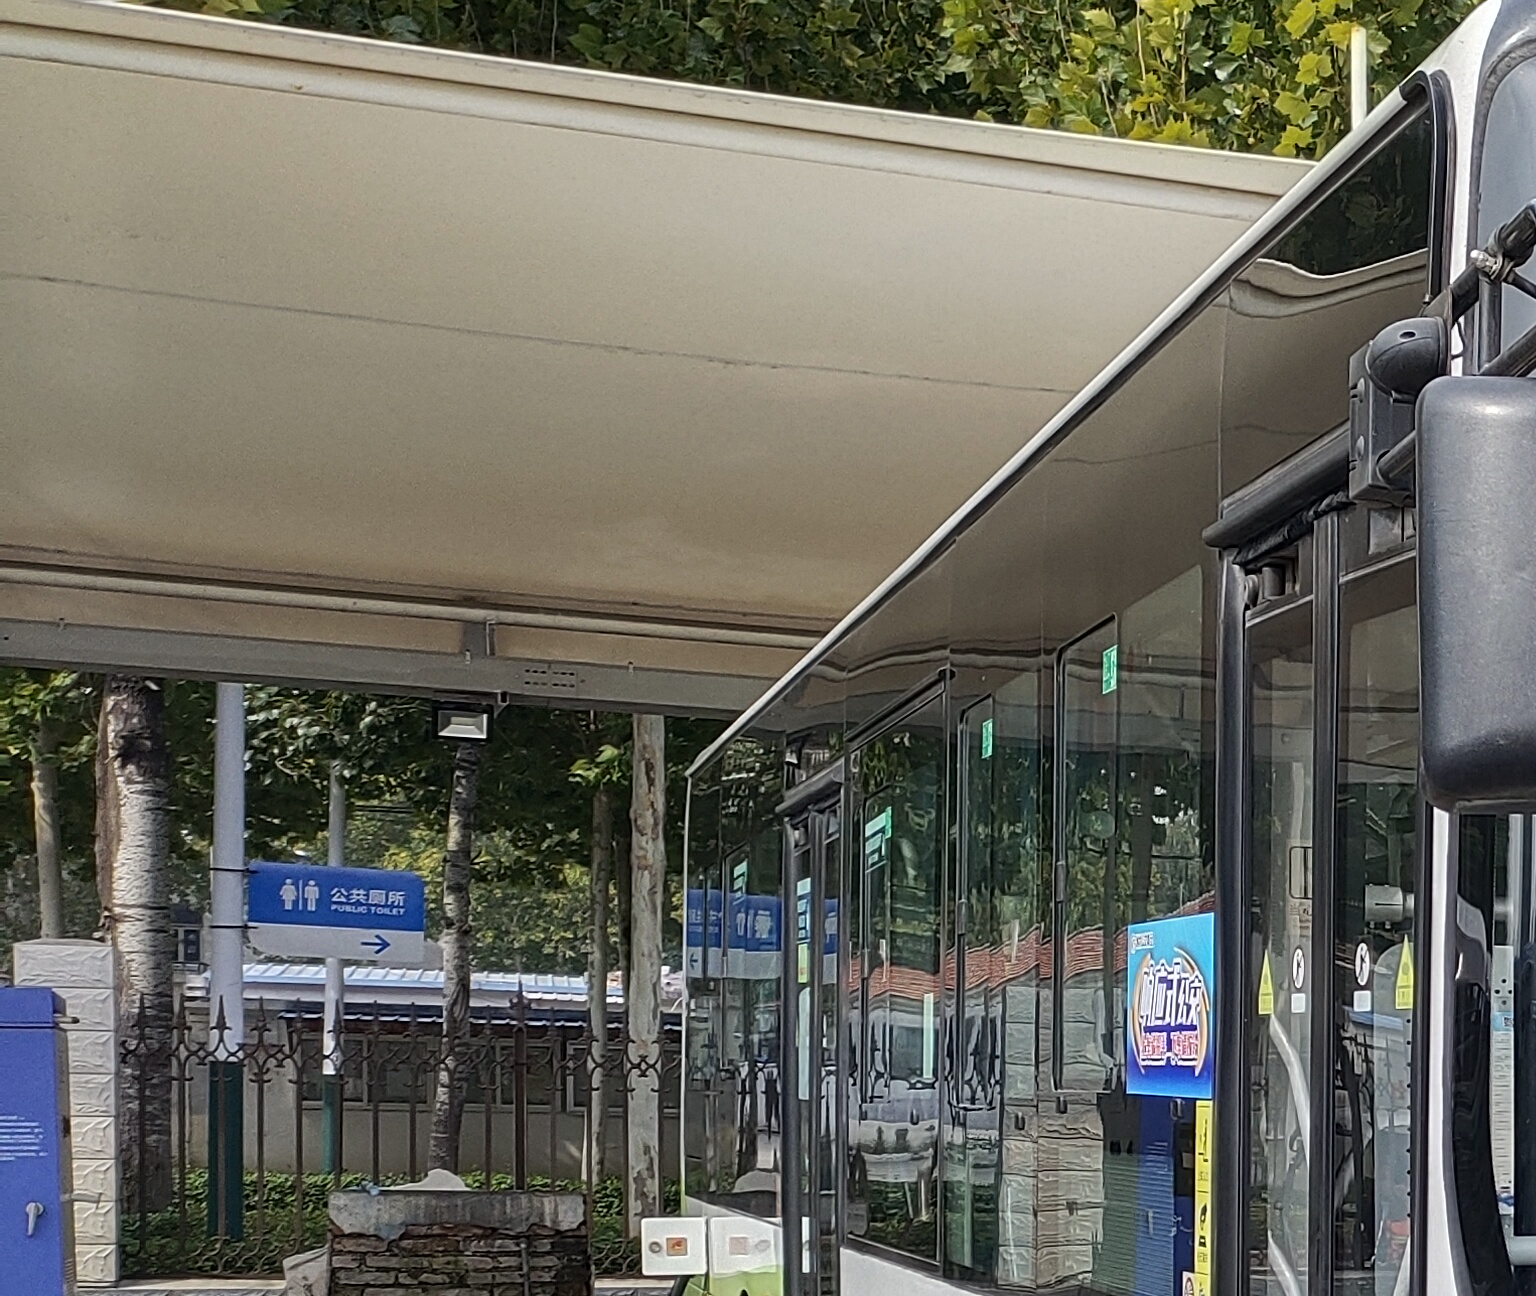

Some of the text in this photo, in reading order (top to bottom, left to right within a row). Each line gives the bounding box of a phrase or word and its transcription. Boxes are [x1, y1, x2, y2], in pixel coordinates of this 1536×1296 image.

[330, 887, 405, 906] 公共厕所
[330, 905, 405, 915] PUBLIC TOILET
